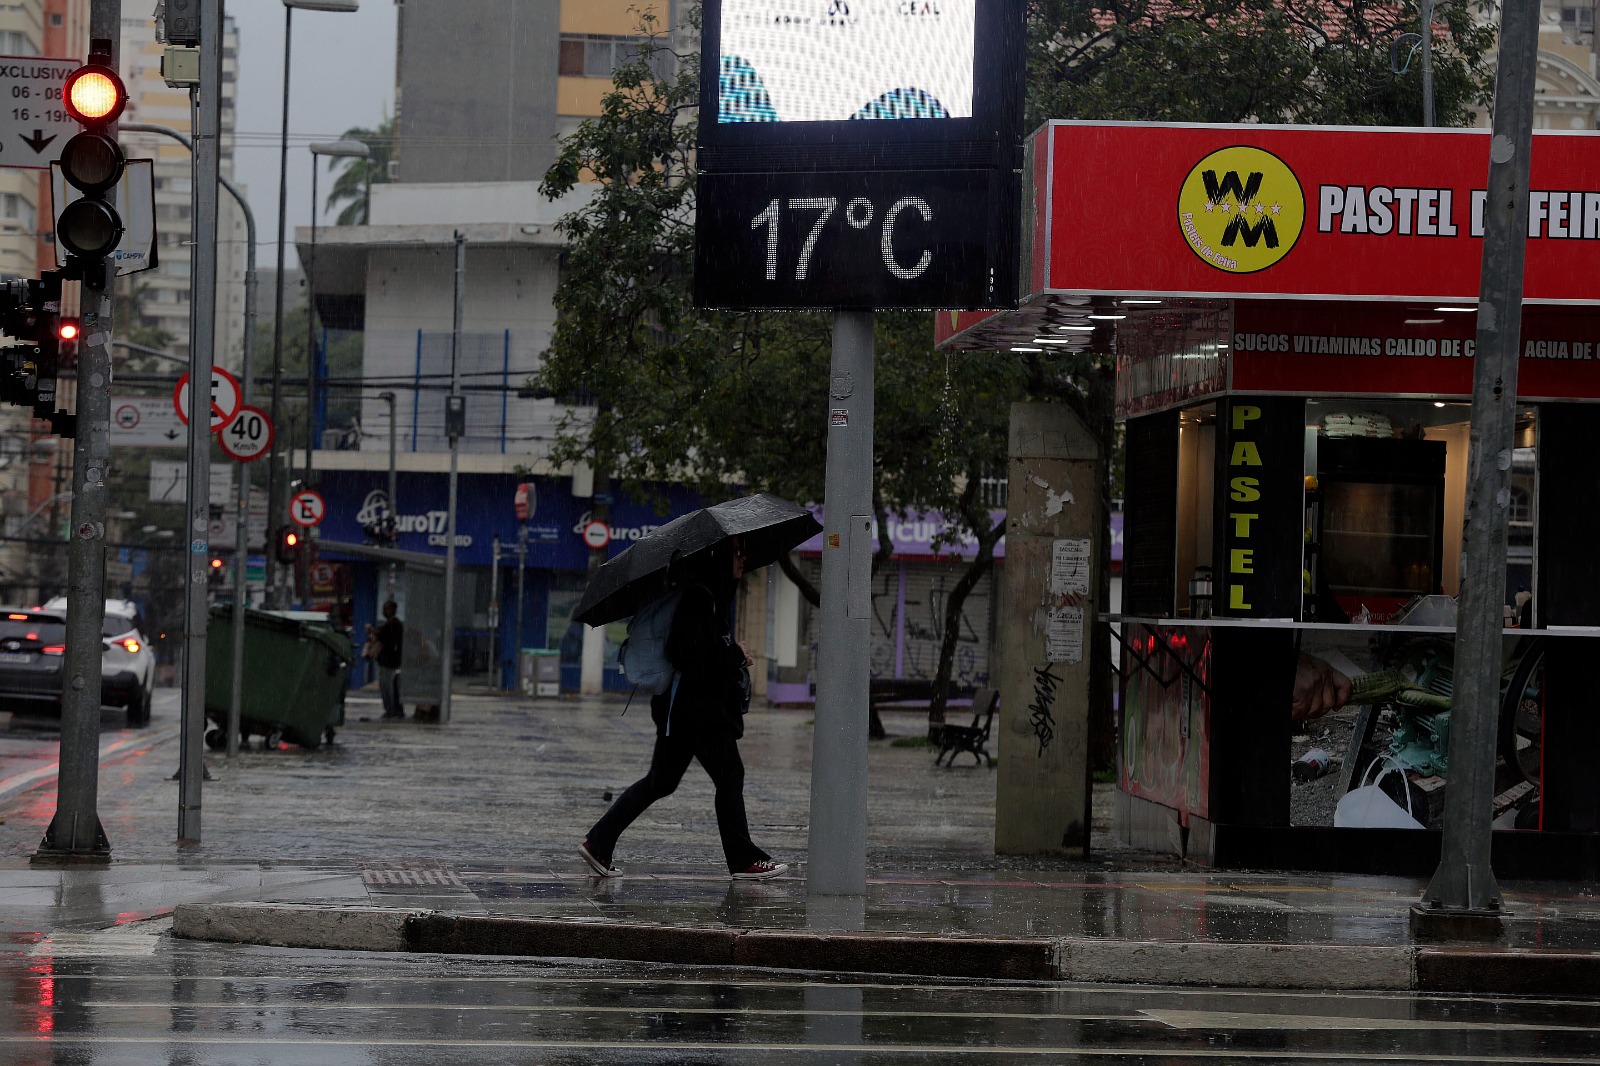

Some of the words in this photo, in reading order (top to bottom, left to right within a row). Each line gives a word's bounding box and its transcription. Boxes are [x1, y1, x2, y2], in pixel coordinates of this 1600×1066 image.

[12, 86, 30, 98] 06
[12, 108, 30, 121] 16
[1318, 184, 1458, 237] PASTEL
[1200, 246, 1214, 258] de
[1212, 252, 1237, 270] Feira
[1234, 333, 1290, 352] SUCOS
[1293, 335, 1382, 356] VITAMINAS
[1385, 337, 1438, 357] CALDO
[1440, 339, 1461, 358] DE
[1524, 340, 1569, 359] AGUA
[1572, 341, 1592, 360] DE
[231, 415, 262, 440] 40
[1229, 405, 1263, 610] PASTEL
